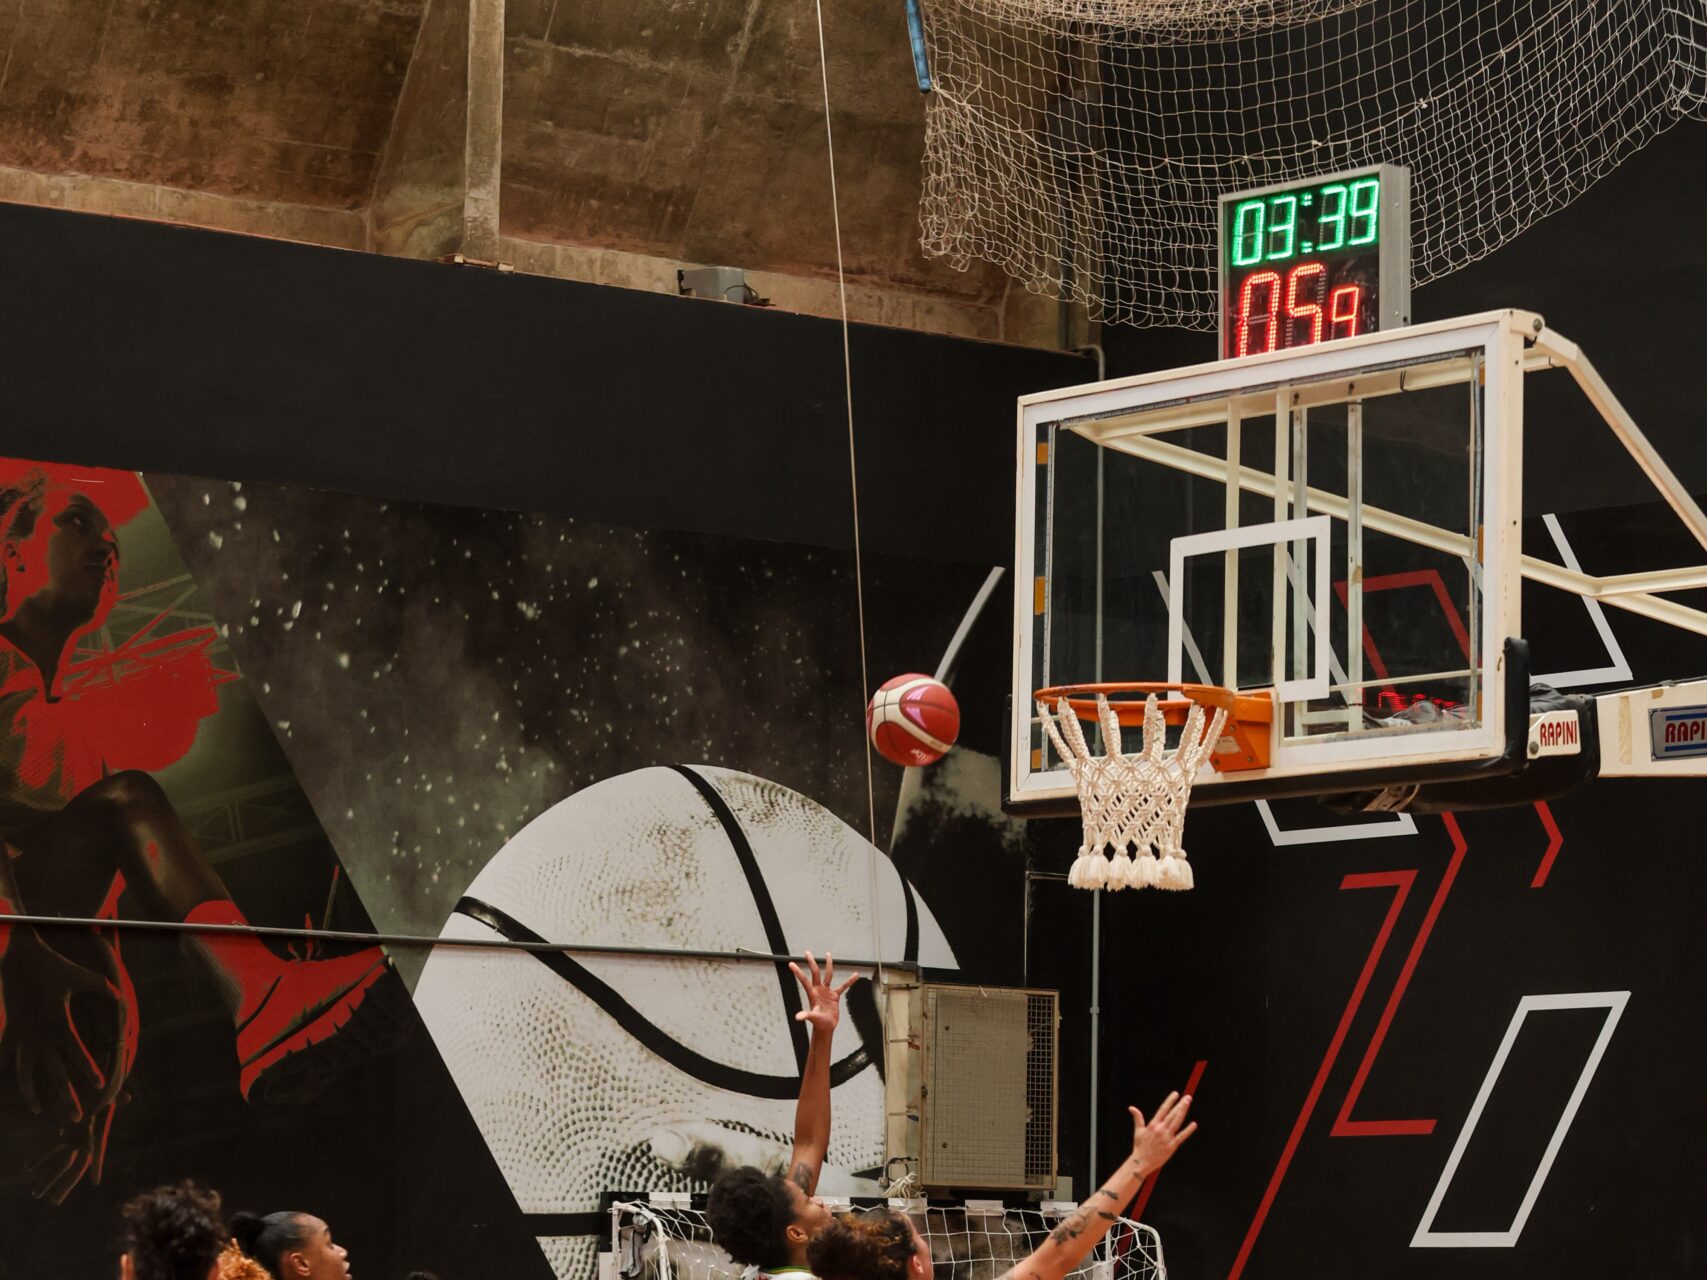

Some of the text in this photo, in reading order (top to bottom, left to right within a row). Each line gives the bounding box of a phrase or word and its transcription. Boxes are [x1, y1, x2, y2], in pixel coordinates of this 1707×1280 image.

[1232, 178, 1379, 266] 03:39
[1539, 720, 1578, 747] RAPINI
[1664, 719, 1707, 744] RAPI
